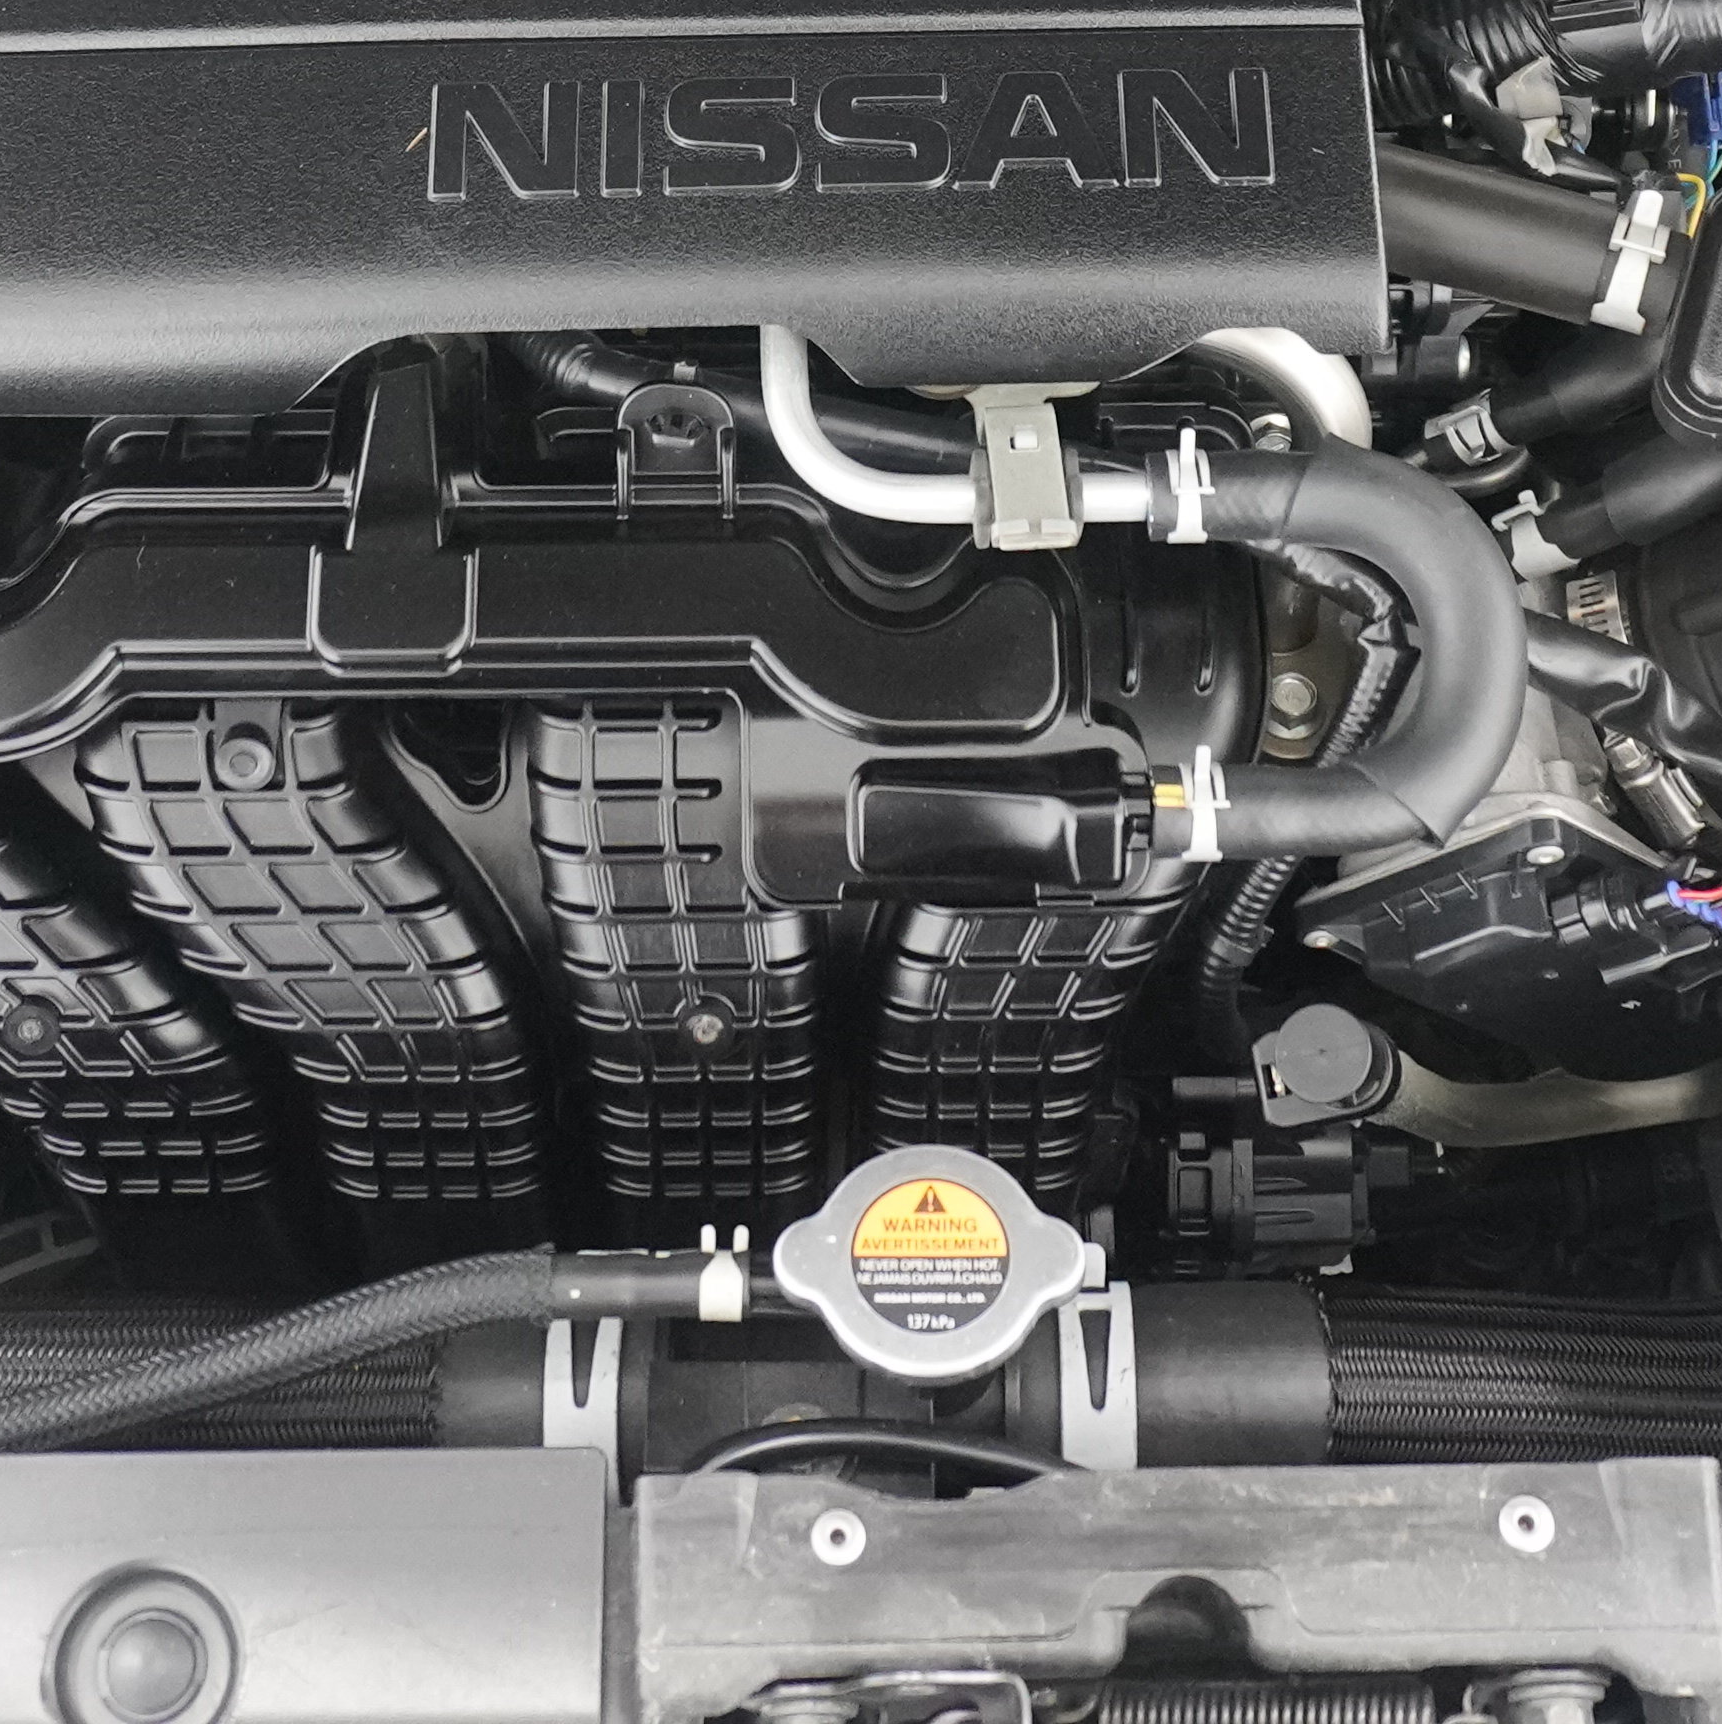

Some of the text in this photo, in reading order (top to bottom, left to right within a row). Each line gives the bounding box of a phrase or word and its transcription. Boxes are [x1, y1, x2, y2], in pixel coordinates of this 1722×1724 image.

[425, 67, 1276, 201] NISSAN
[883, 1218, 977, 1233] WARNING
[861, 1238, 999, 1251] AVERTISSEMENT
[859, 1258, 899, 1271] NEVER
[900, 1258, 934, 1271] OPEN
[935, 1258, 972, 1271] WHEN
